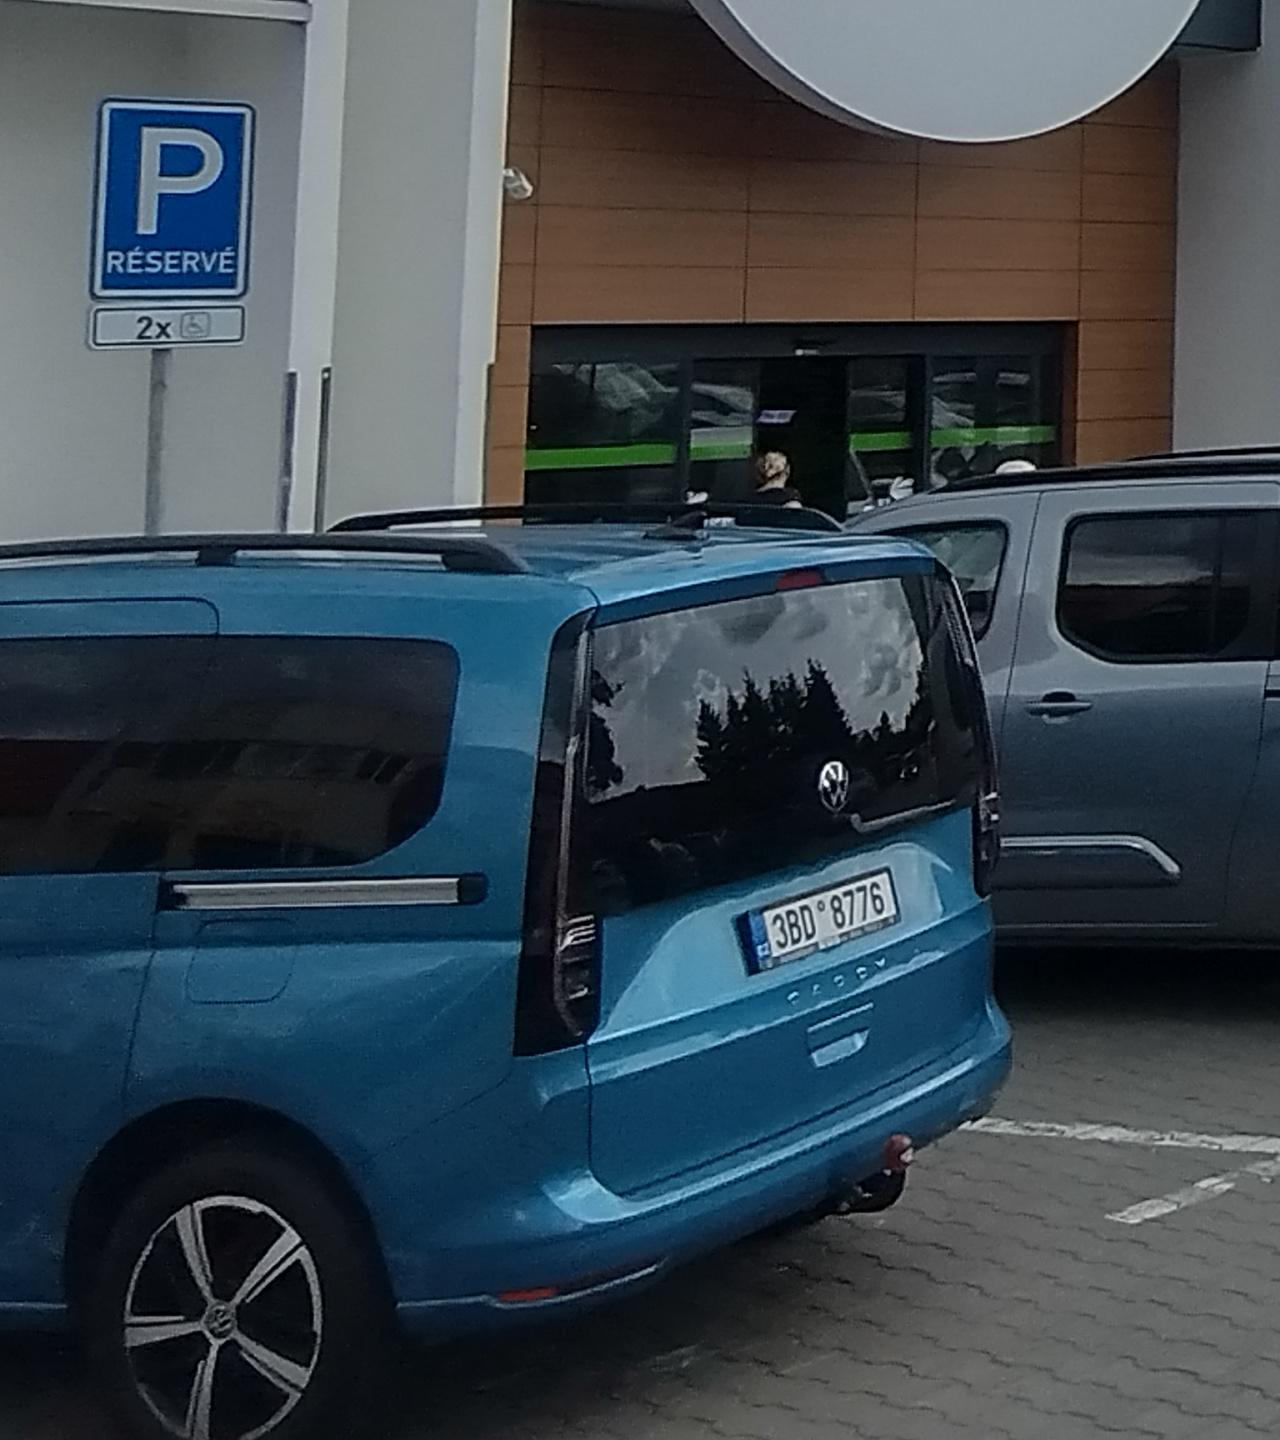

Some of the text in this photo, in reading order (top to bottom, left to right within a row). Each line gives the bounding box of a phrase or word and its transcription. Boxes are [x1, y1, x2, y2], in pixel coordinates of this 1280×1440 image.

[136, 126, 224, 235] P
[106, 246, 236, 274] RÉSERVÉ
[136, 316, 172, 340] 2x
[772, 904, 816, 949] 3BD
[830, 881, 885, 930] 8776
